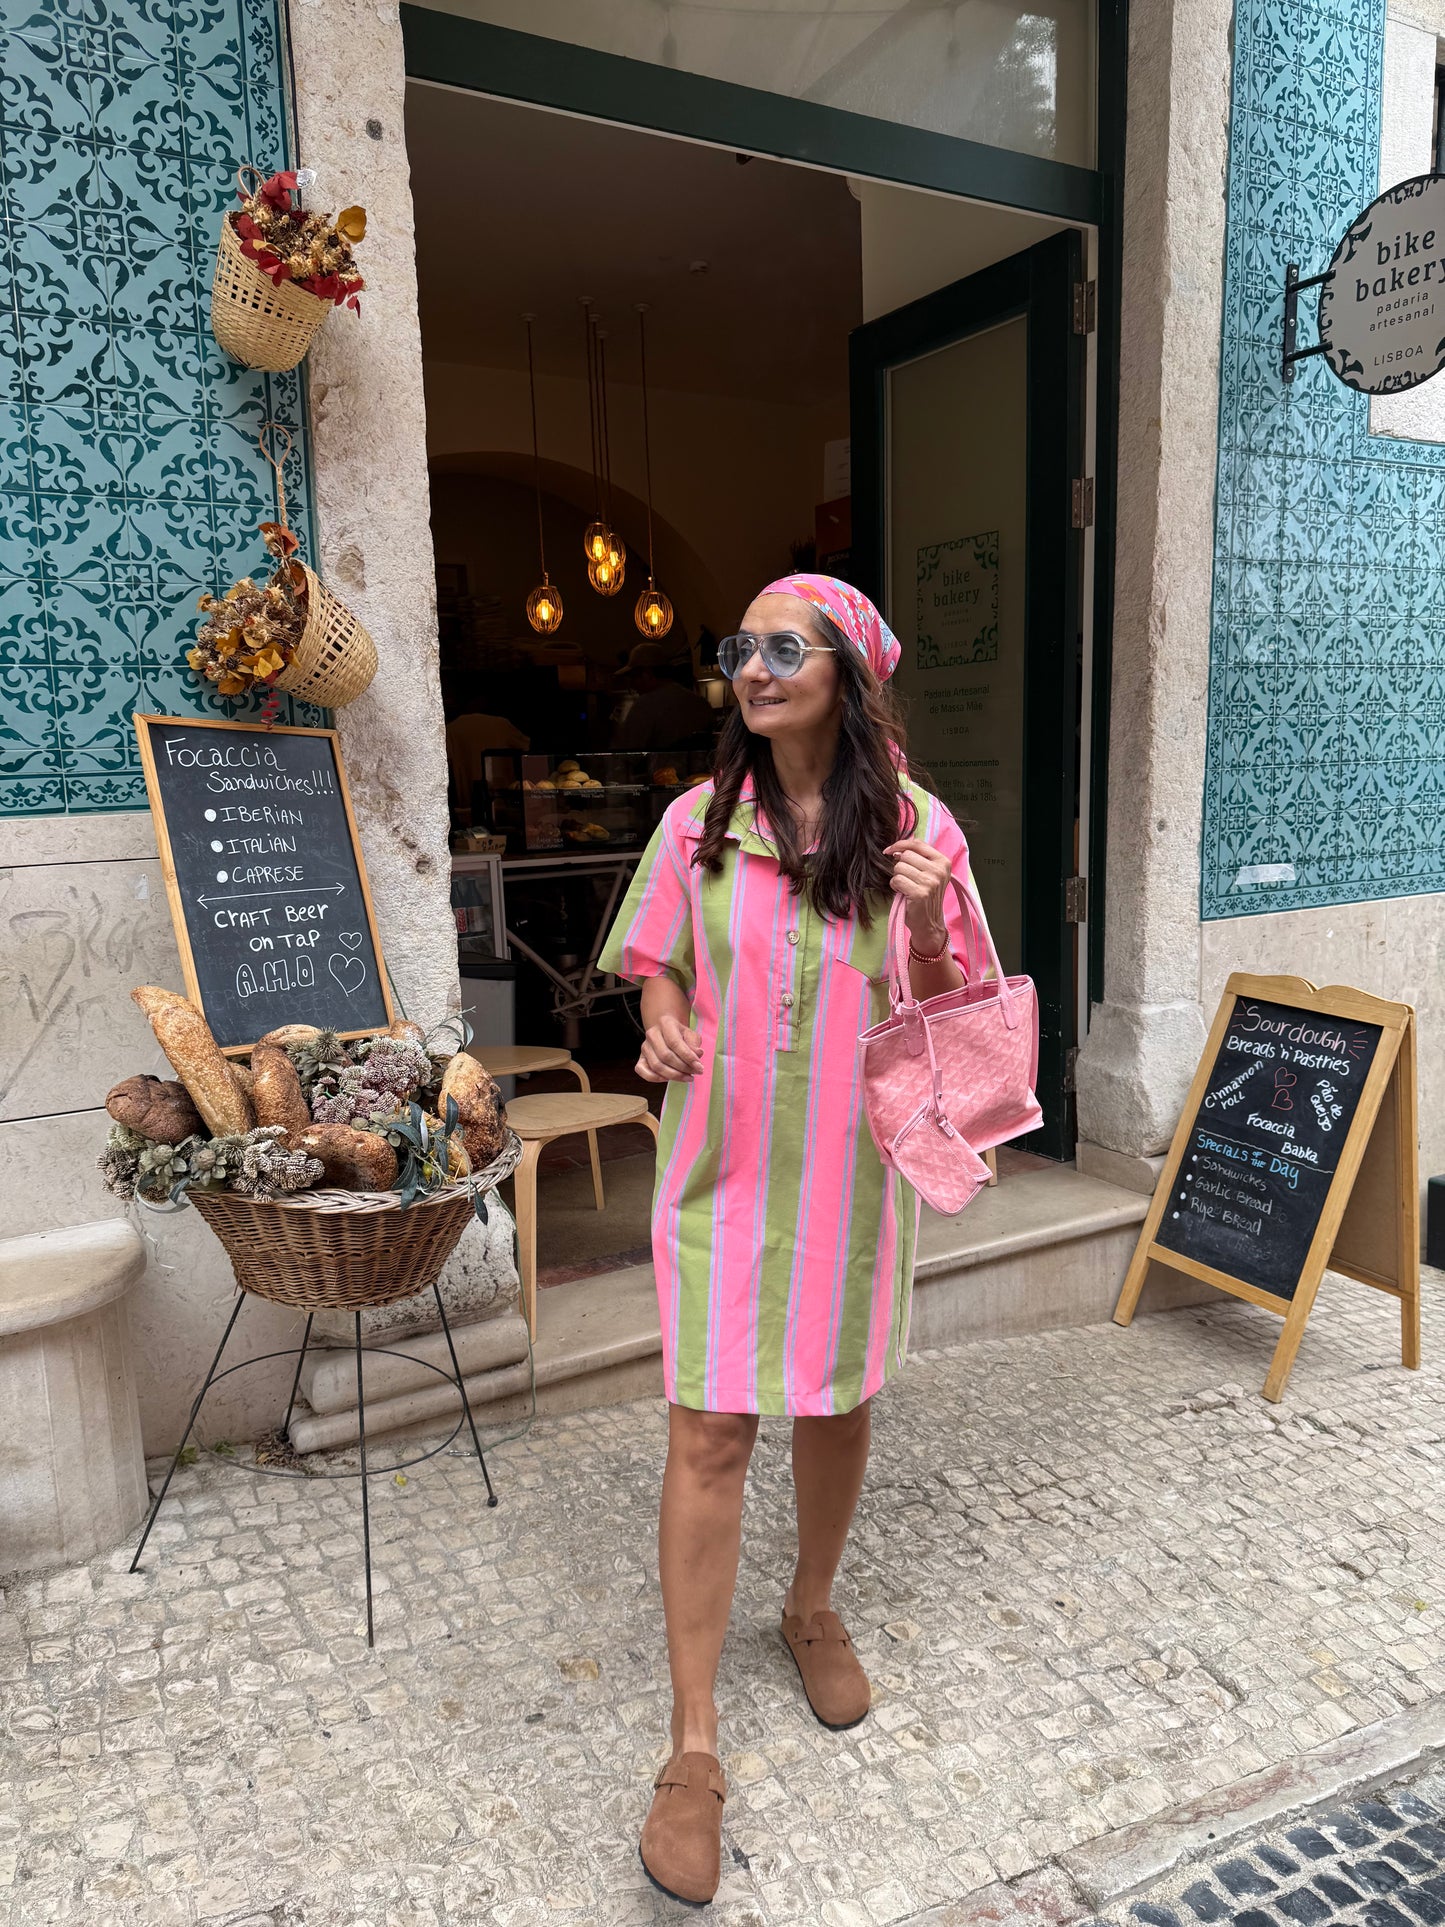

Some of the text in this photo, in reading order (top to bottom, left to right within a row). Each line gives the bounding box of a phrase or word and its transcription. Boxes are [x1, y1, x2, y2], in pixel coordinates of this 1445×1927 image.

[1377, 230, 1436, 266] bike
[1369, 304, 1435, 332] artesanal
[1376, 292, 1429, 317] padaria
[1373, 345, 1424, 367] LISBOA
[942, 568, 971, 588] bike
[933, 587, 980, 608] bakery
[953, 684, 990, 697] Artesanal
[929, 704, 939, 714] de
[165, 737, 286, 771] Focaccia
[206, 769, 335, 796] Sandwiches!!!
[231, 865, 305, 884] CAPRESE
[284, 903, 329, 923] Beer
[1226, 1035, 1276, 1059] Breads
[1293, 1049, 1351, 1077] Pastries
[1204, 1060, 1264, 1109] Cinnamon
[1316, 1079, 1344, 1120] Pão de
[1246, 1111, 1296, 1140] Focaccia
[1280, 1141, 1319, 1165] Babka
[1202, 1156, 1268, 1192] Sandwiches
[1269, 1158, 1300, 1190] Day
[1190, 1196, 1216, 1223] Rye
